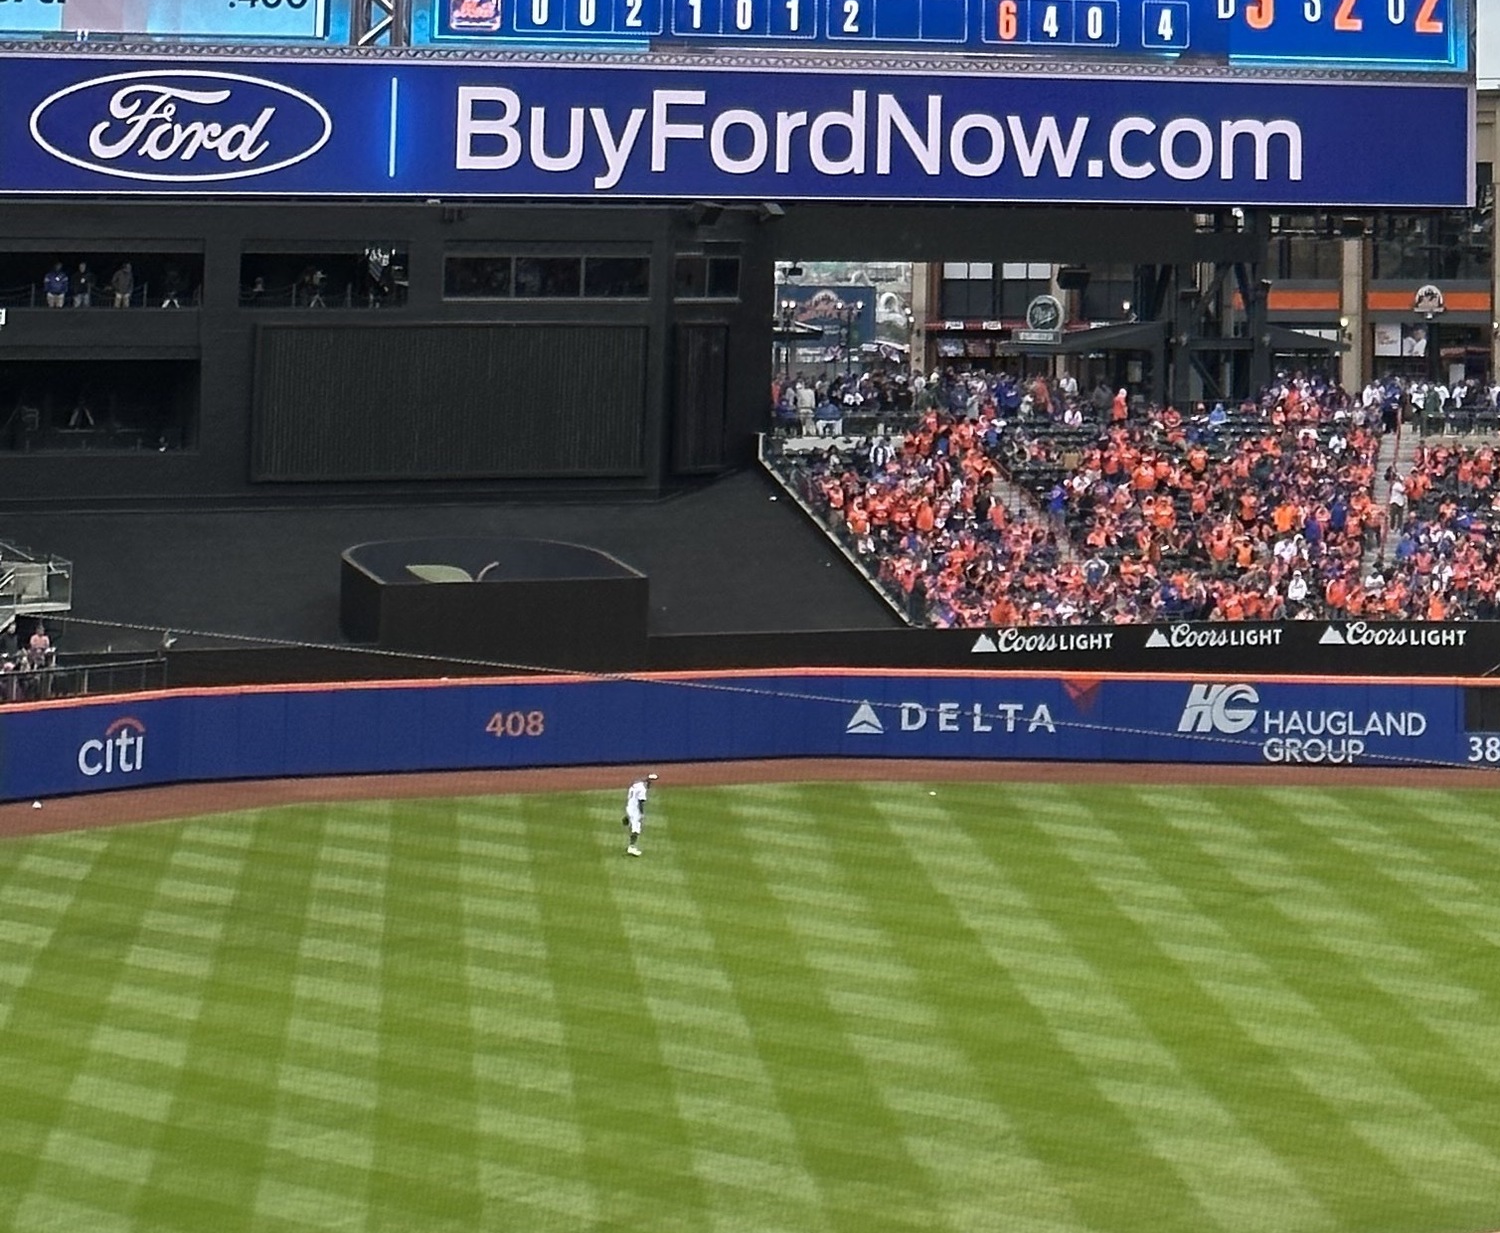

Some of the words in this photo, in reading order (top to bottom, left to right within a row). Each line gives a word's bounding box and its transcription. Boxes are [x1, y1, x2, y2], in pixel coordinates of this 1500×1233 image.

[88, 84, 275, 162] Ford
[455, 86, 1304, 188] BuyFordNow.com
[996, 627, 1059, 653] Coors
[1059, 632, 1115, 652] LIGHT
[1168, 623, 1229, 649] Coors
[1230, 627, 1283, 648] LIGHT
[1344, 620, 1410, 648] Coors
[1410, 627, 1467, 647] LIGHT
[900, 702, 1057, 734] DELTA
[1178, 683, 1260, 734] HG
[485, 711, 545, 737] 408
[1264, 711, 1427, 737] HAUGLAND
[78, 726, 143, 776] citi
[1263, 739, 1365, 764] GROUP
